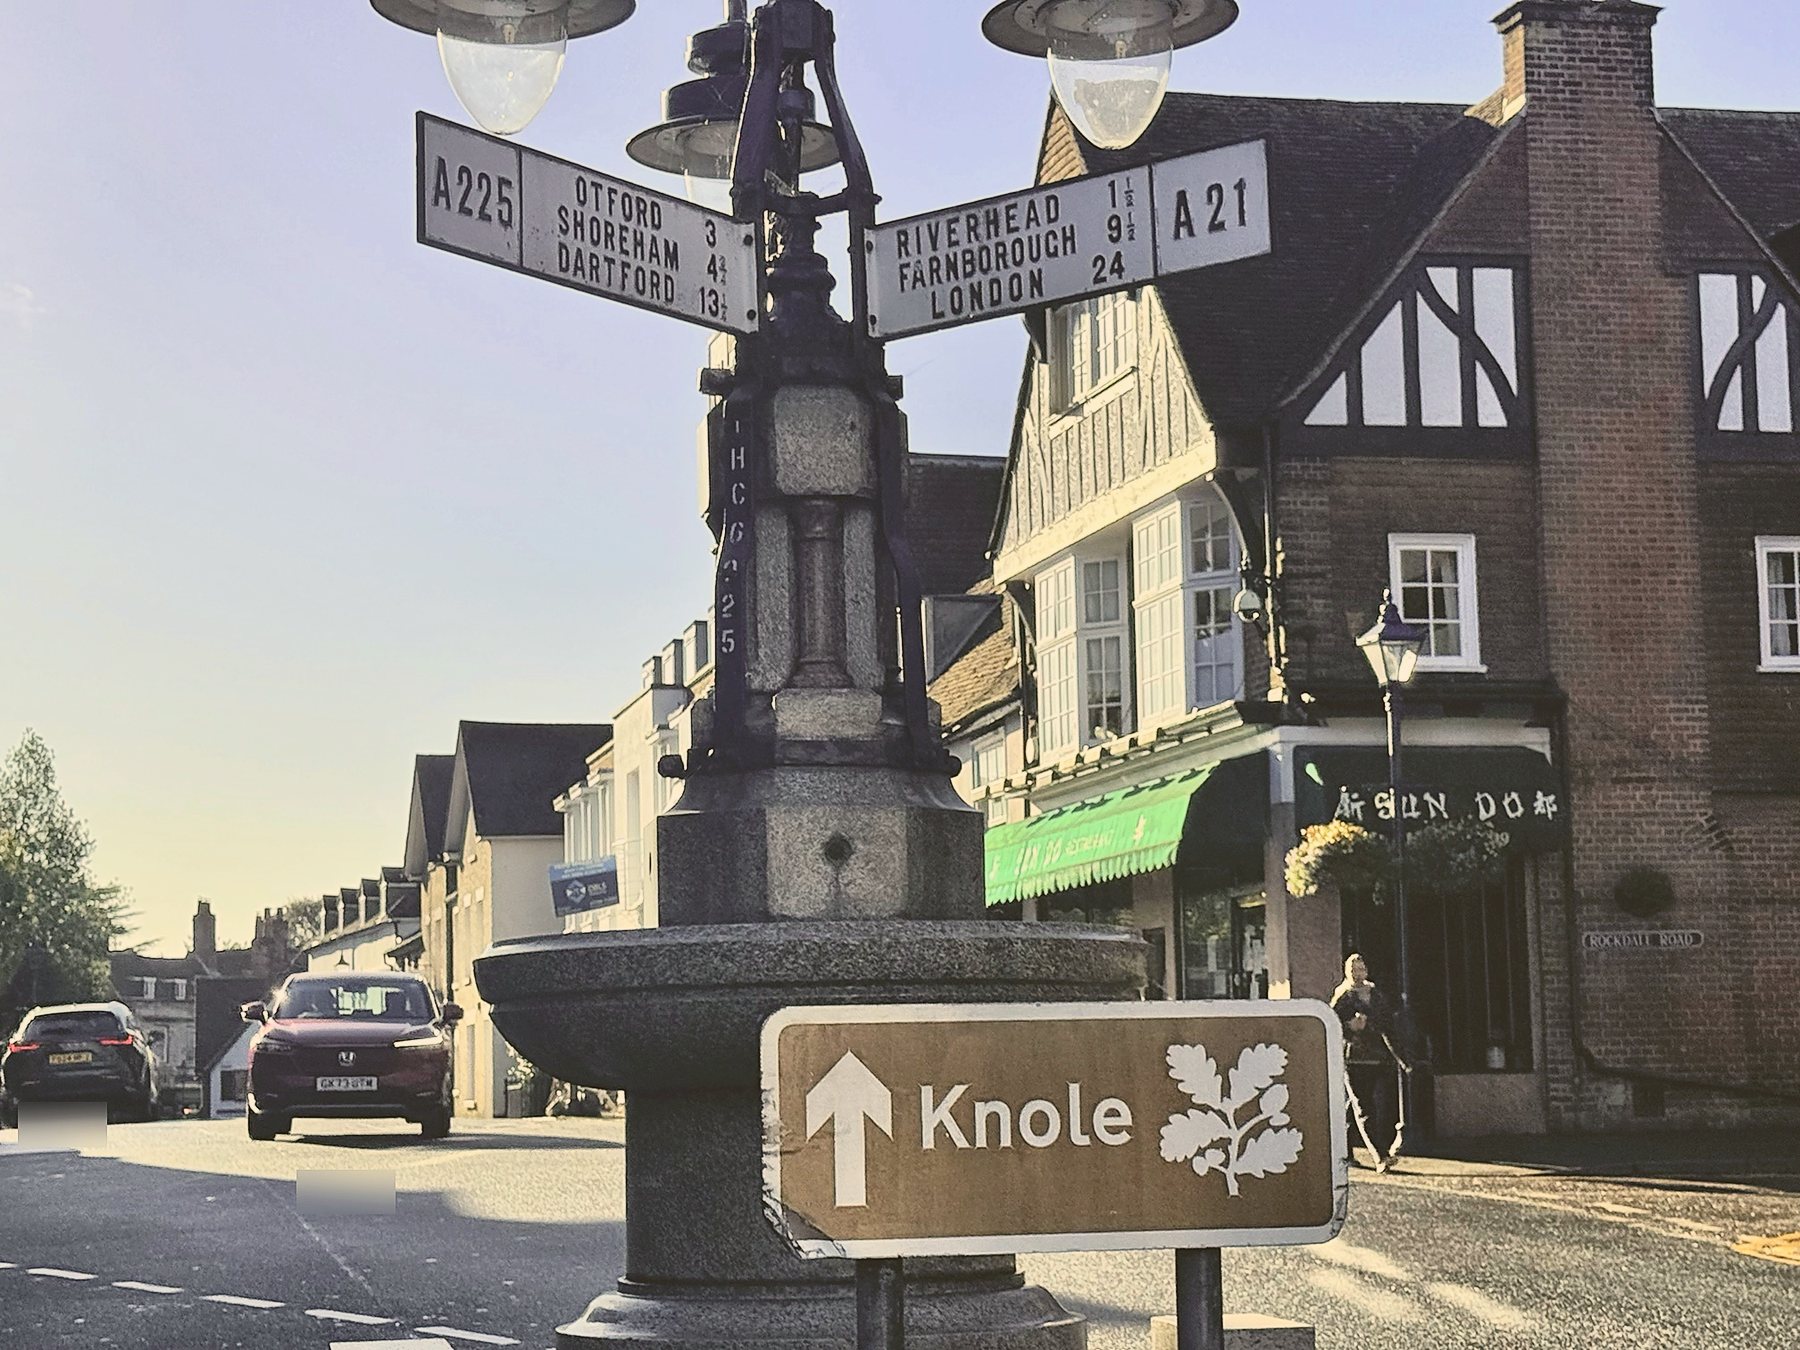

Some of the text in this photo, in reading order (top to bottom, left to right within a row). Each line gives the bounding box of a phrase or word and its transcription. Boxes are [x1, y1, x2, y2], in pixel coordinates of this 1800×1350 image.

[431, 156, 513, 228] A225
[575, 175, 716, 248] OTFORD 3
[557, 205, 680, 272] SHOREHAM
[897, 194, 1060, 259] RIVERHEAD
[900, 224, 1077, 293] FARNBOROUGH
[558, 242, 675, 304] DARTFORD
[931, 251, 1125, 319] LONDON 24
[1374, 790, 1449, 820] SUN
[1475, 791, 1524, 821] DO
[1660, 933, 1693, 947] ROAD
[920, 1082, 1134, 1150] Knole
